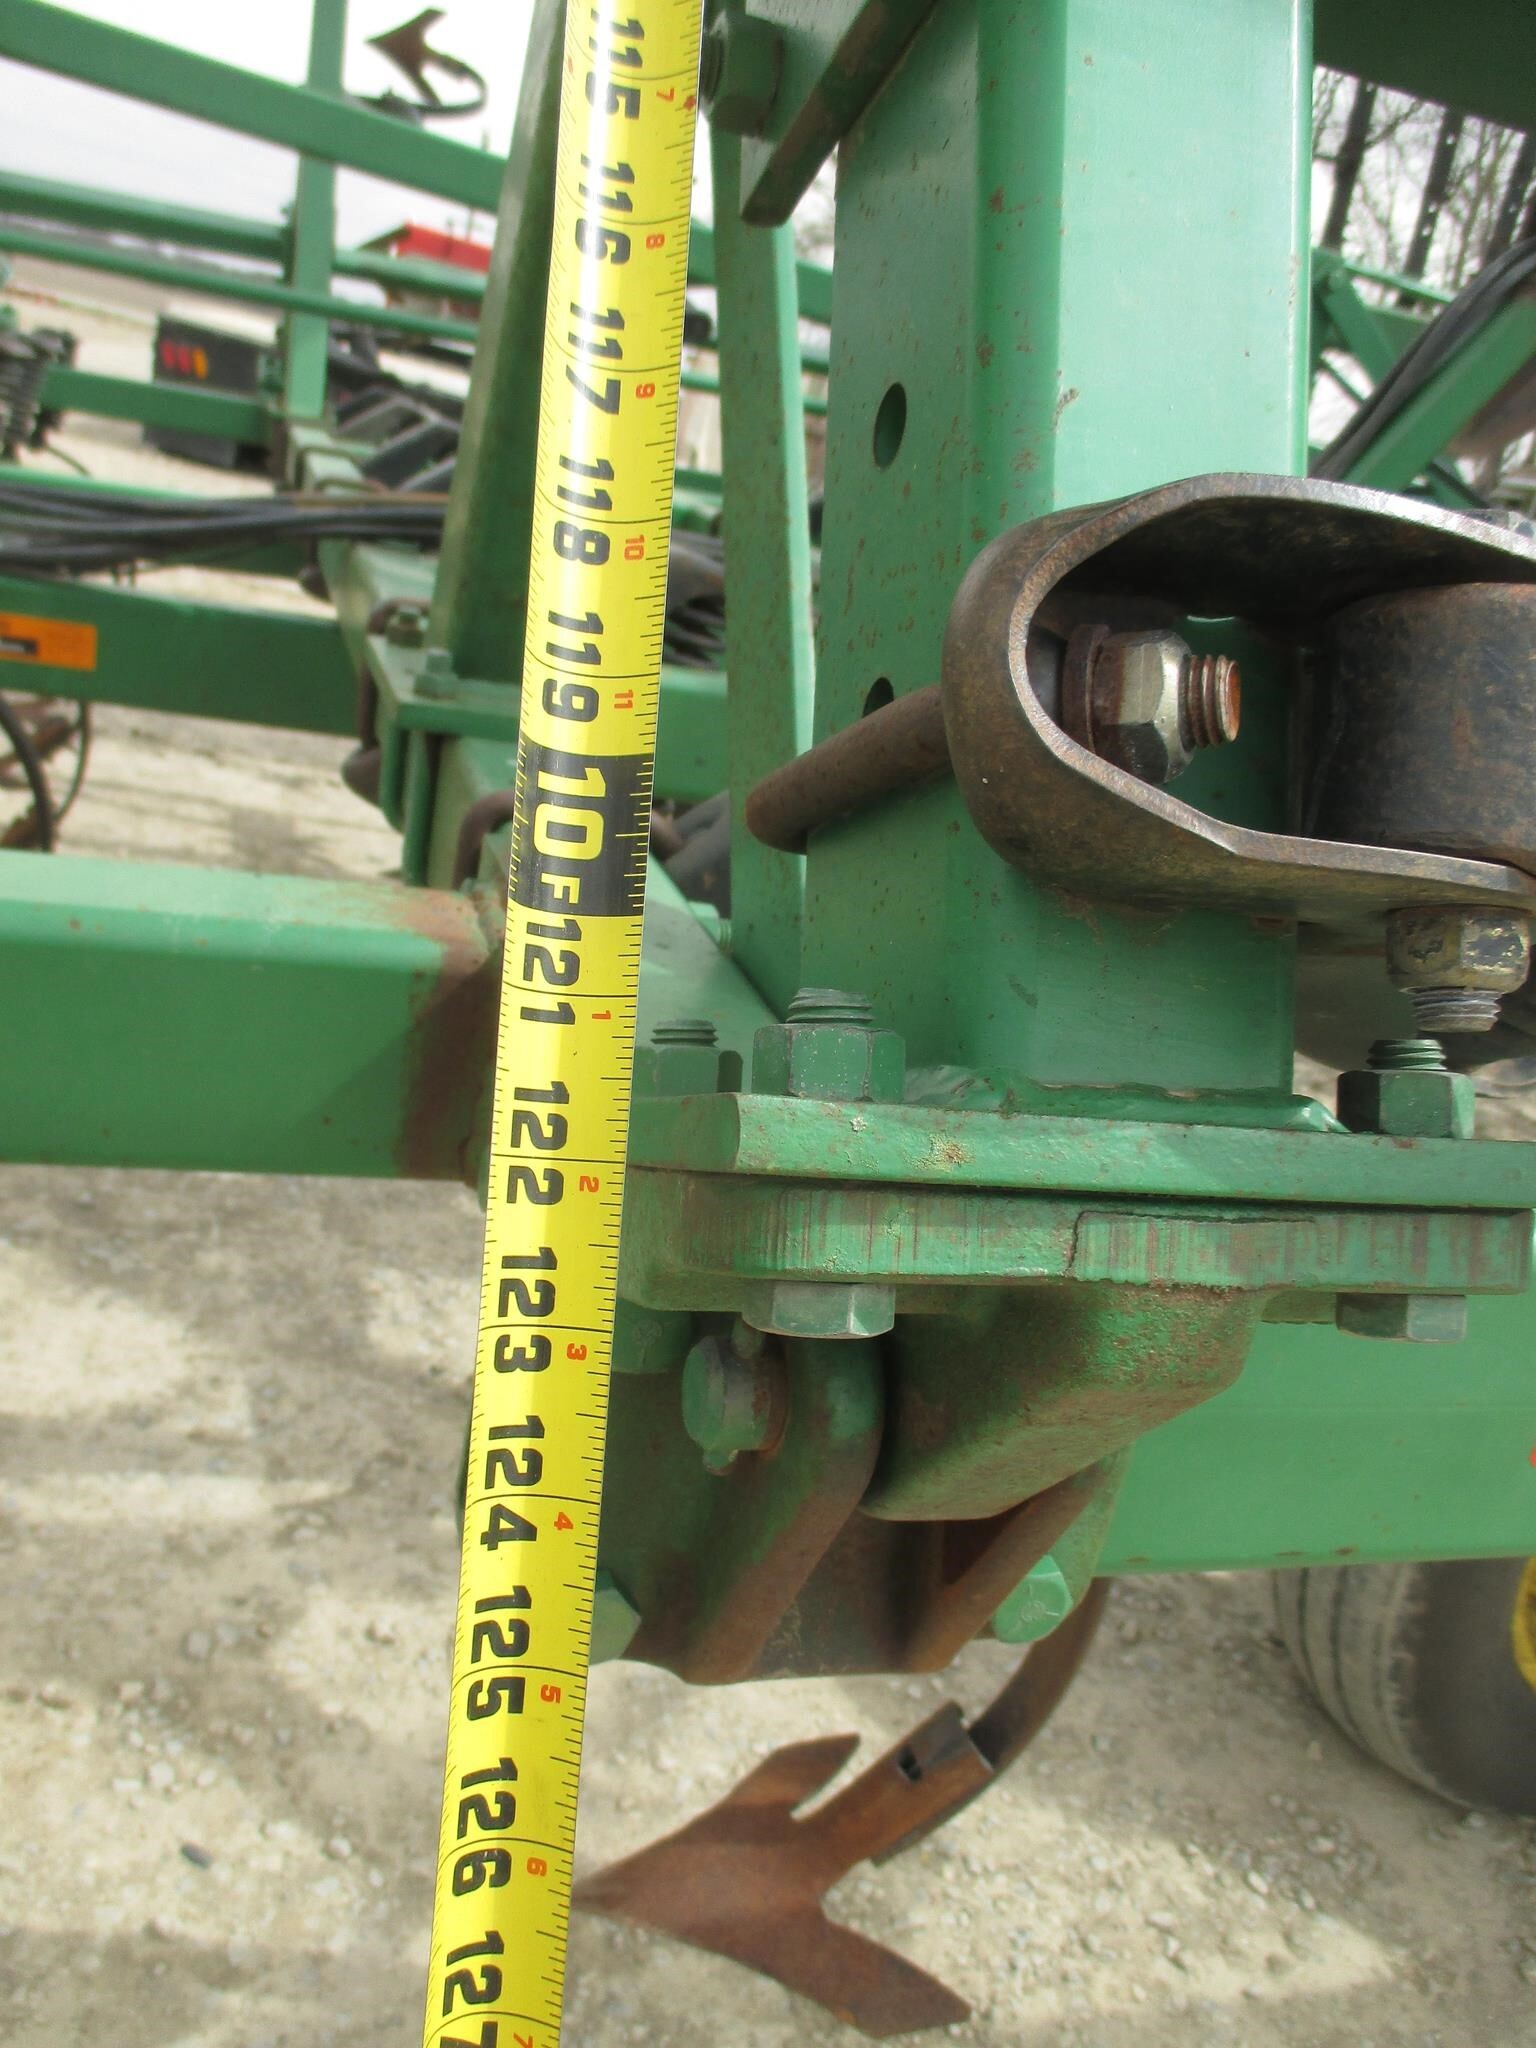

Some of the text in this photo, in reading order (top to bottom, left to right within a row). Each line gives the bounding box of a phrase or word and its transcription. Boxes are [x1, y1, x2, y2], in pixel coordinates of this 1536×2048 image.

[585, 8, 644, 120] 115
[575, 152, 635, 265] 116
[646, 234, 665, 249] 8
[566, 302, 625, 415] 117
[636, 383, 655, 399] 9
[553, 455, 614, 566] 118
[624, 534, 645, 560] 10
[542, 610, 603, 722] 119
[614, 689, 634, 709] 11
[520, 919, 582, 1025] 121
[592, 1010, 611, 1020] 1
[506, 1080, 570, 1205] 122
[579, 1175, 599, 1193] 2
[494, 1246, 557, 1373] 123
[566, 1342, 587, 1361] 3
[480, 1415, 545, 1551] 124
[553, 1511, 574, 1531] 4
[467, 1585, 532, 1721] 125
[540, 1684, 561, 1704] 5
[452, 1757, 518, 1897] 126
[526, 1857, 547, 1876] 6
